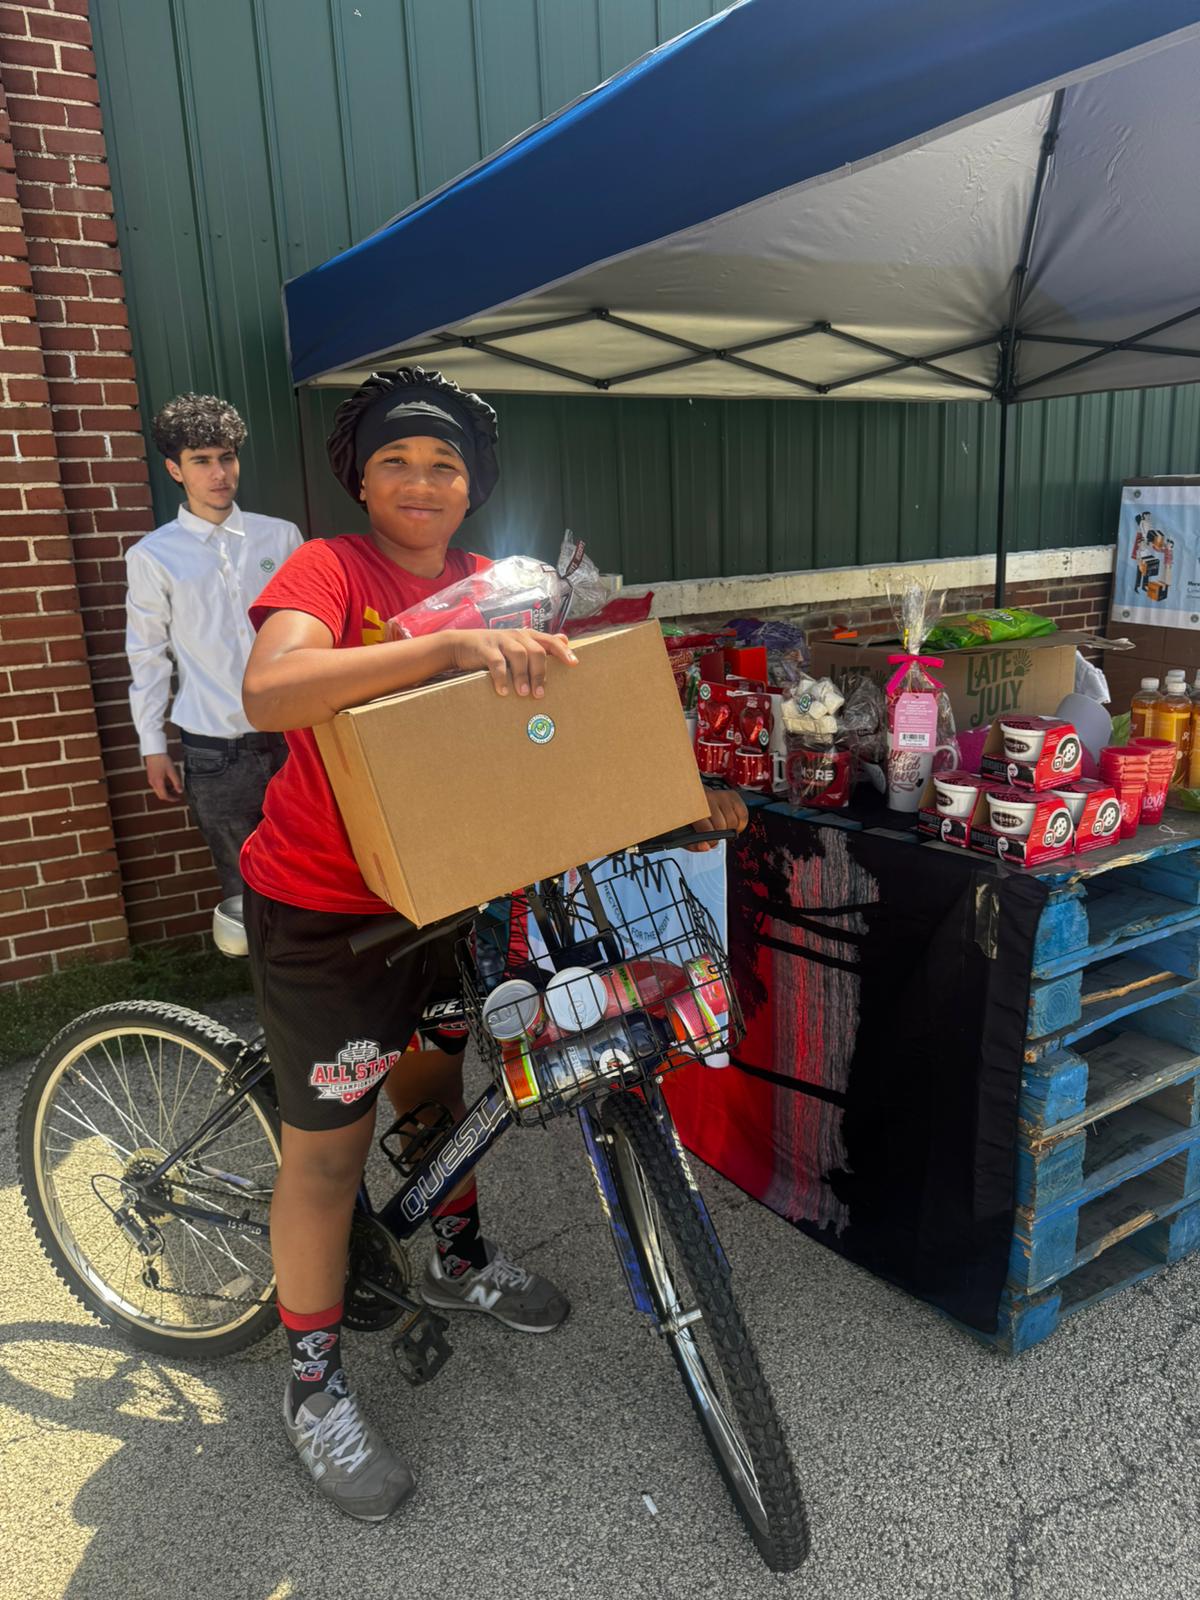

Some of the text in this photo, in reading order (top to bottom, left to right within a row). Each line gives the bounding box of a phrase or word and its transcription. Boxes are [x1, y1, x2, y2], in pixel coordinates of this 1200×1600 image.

[967, 651, 1014, 697] LATE
[969, 680, 1024, 728] JULY
[313, 1051, 400, 1084] ALL STAR
[400, 1096, 511, 1222] QUEST
[227, 1220, 237, 1229] 15
